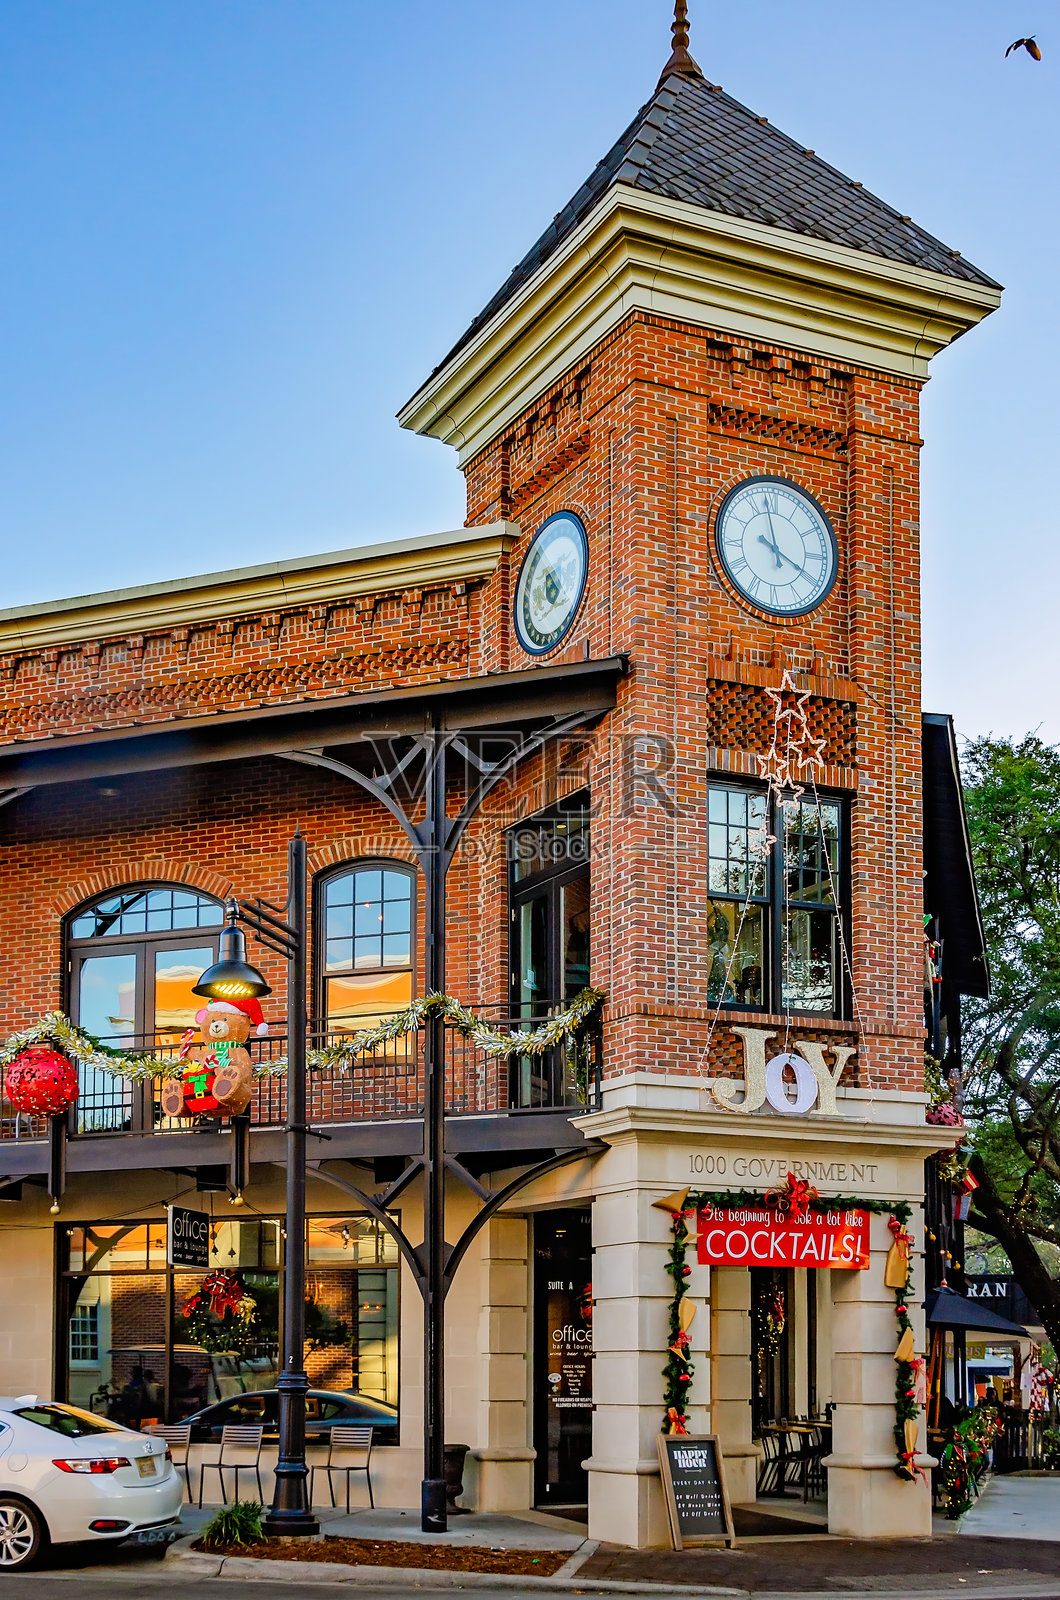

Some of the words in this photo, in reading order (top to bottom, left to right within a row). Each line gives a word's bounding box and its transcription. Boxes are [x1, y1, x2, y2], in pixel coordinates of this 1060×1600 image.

[711, 1026, 857, 1116] JOY
[688, 1154, 727, 1175] 1000
[733, 1157, 879, 1184] GOVERNMENT
[728, 1208, 771, 1228] beginning
[774, 1209, 785, 1224] to
[793, 1213, 812, 1226] ook
[816, 1215, 824, 1226] a
[826, 1210, 841, 1227] lot
[845, 1211, 864, 1228] like
[174, 1212, 208, 1241] office
[173, 1239, 183, 1249] bar
[184, 1240, 189, 1250] &
[190, 1241, 208, 1255] lounge
[706, 1229, 862, 1263] COCKTAILS!
[548, 1281, 564, 1290] SUITE
[568, 1281, 574, 1290] A
[552, 1325, 592, 1342] office
[573, 1343, 593, 1351] loung
[288, 1355, 294, 1364] 2
[674, 1450, 707, 1460] HAPPY
[679, 1459, 706, 1467] HOUR
